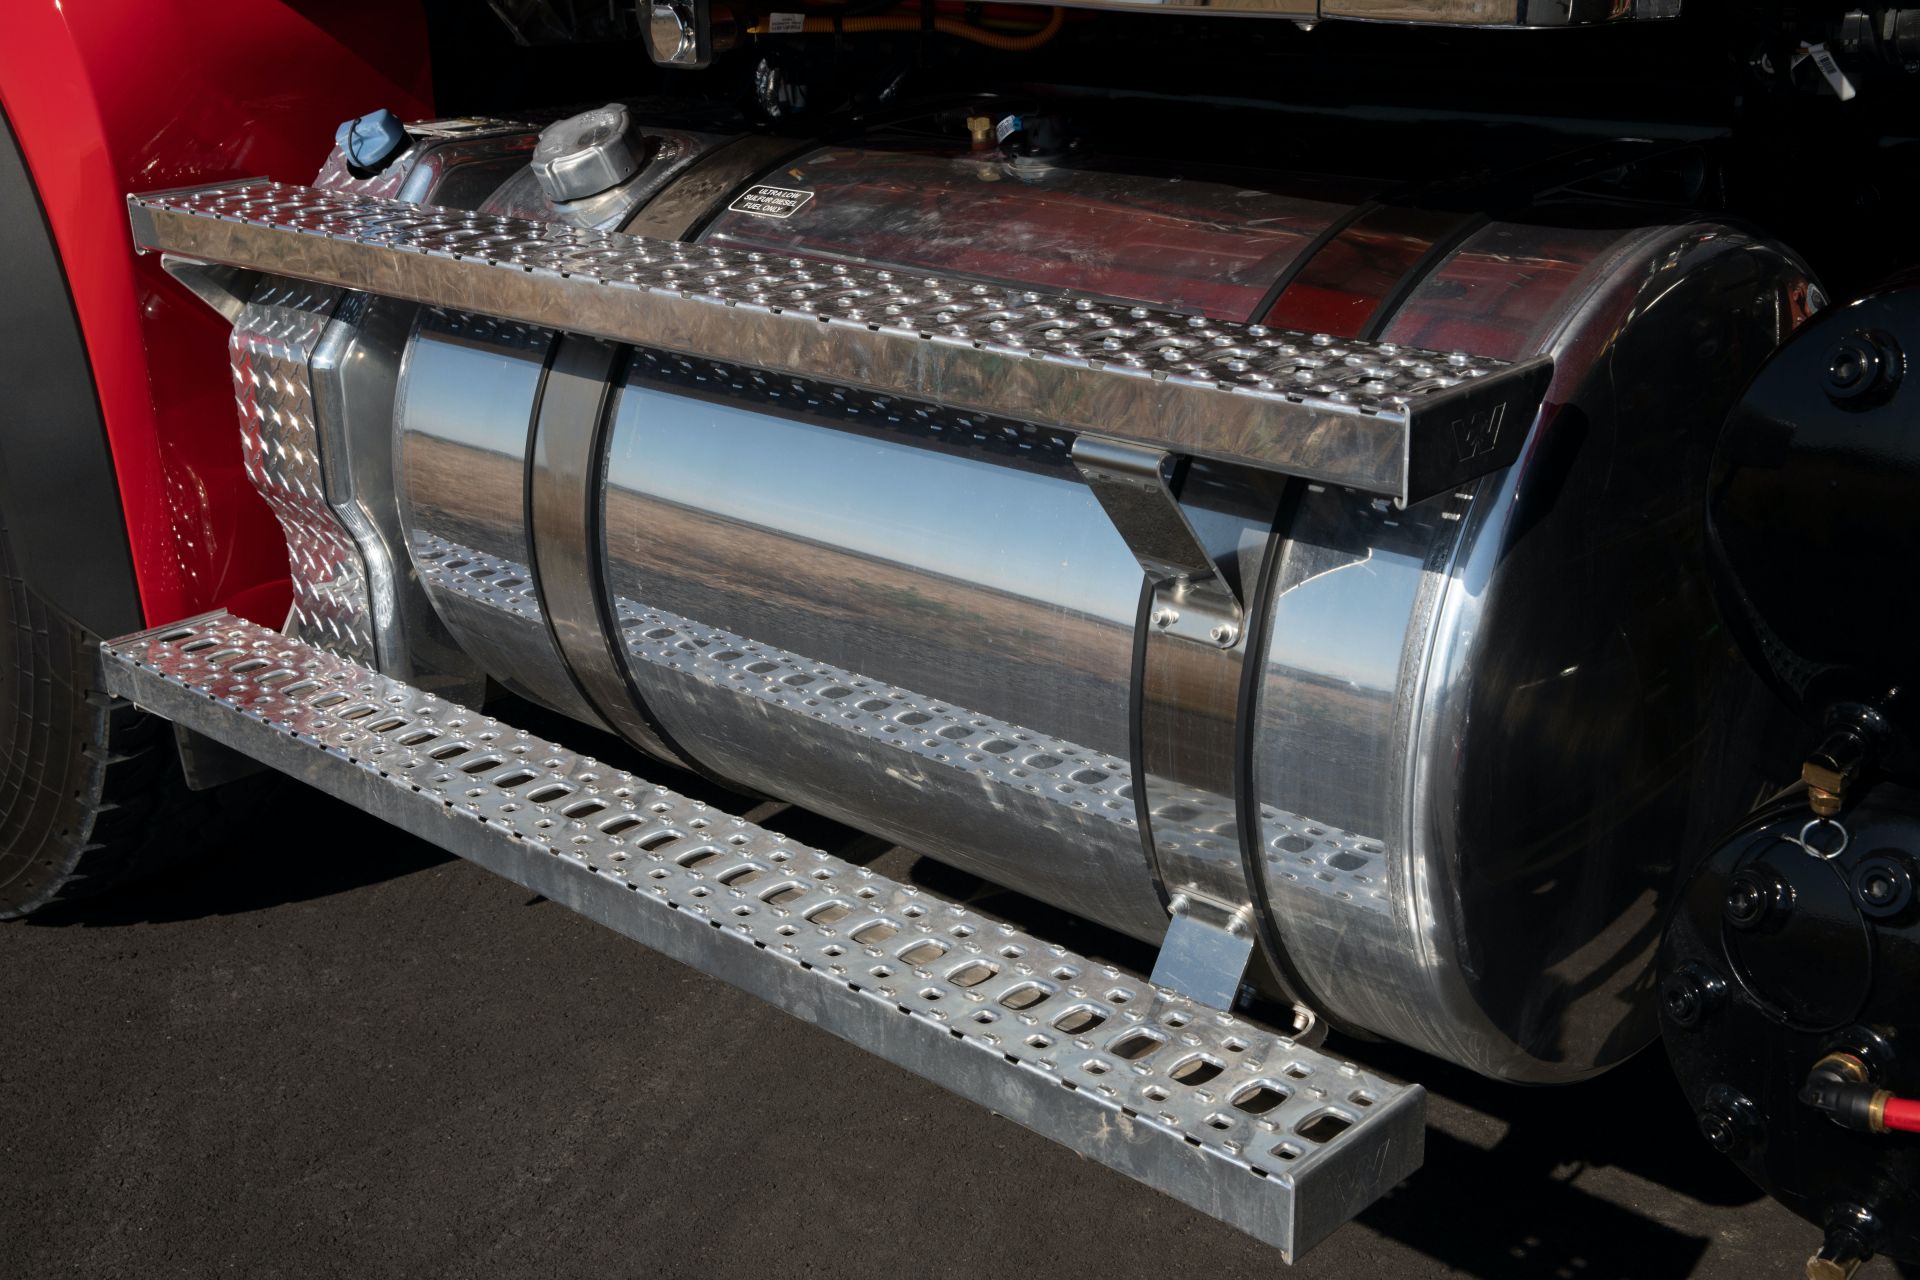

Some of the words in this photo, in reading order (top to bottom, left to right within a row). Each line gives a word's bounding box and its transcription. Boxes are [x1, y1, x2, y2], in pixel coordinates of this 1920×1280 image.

[758, 188, 782, 197] ULTRA
[782, 191, 802, 199] LOW
[744, 194, 773, 204] SULFUR
[771, 197, 797, 207] DIESEL
[743, 202, 762, 210] FUEL
[762, 204, 783, 213] ONLY
